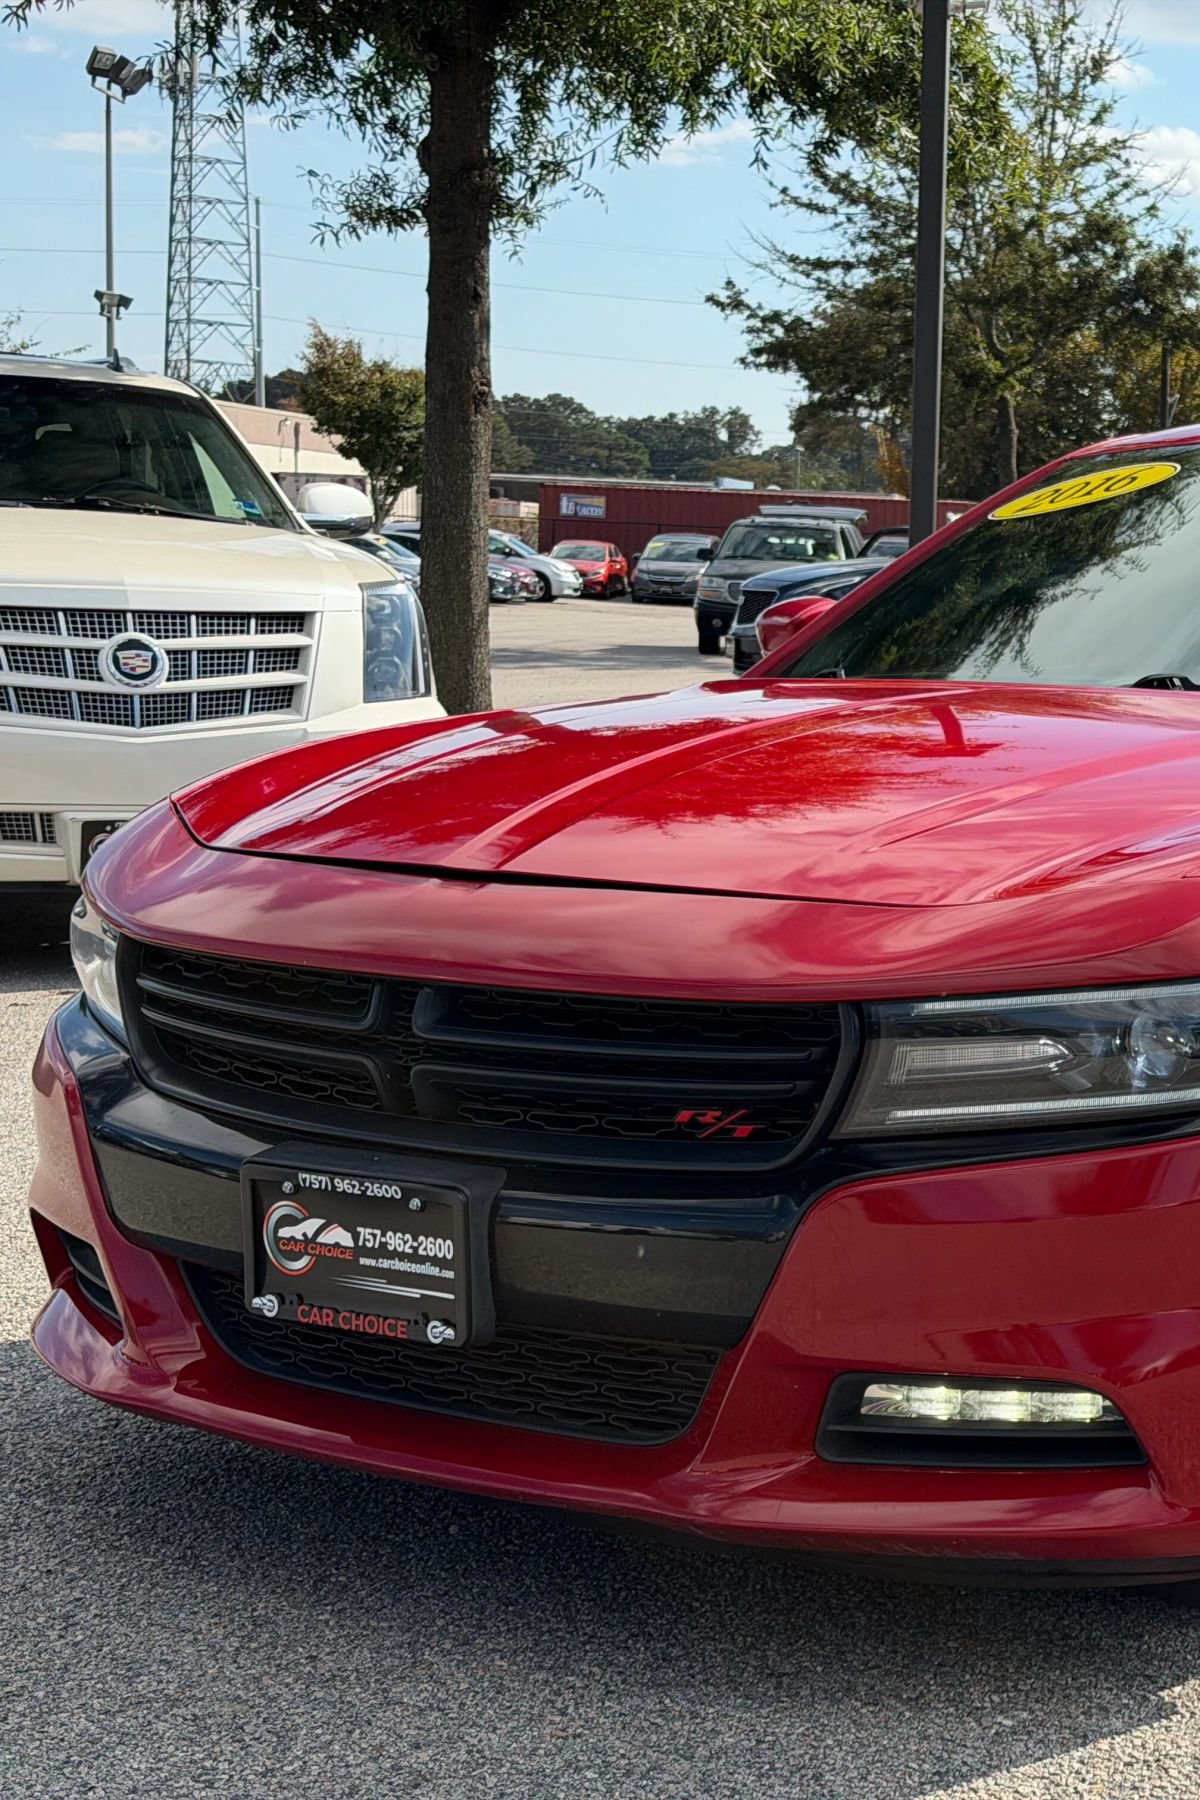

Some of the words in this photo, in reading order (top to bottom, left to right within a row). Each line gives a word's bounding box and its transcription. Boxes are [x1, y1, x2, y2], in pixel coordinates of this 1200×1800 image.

[1011, 466, 1156, 514] 2016
[674, 1109, 767, 1138] R/T
[298, 1172, 332, 1192] (757)
[333, 1178, 402, 1199] 962-2600
[278, 1239, 305, 1252] CAR
[308, 1243, 354, 1260] CHOICE
[356, 1226, 454, 1260] 757-962-2600
[359, 1256, 455, 1280] www.carchoiceonline.com
[297, 1304, 336, 1328] CAR
[339, 1311, 409, 1339] CHOICE
